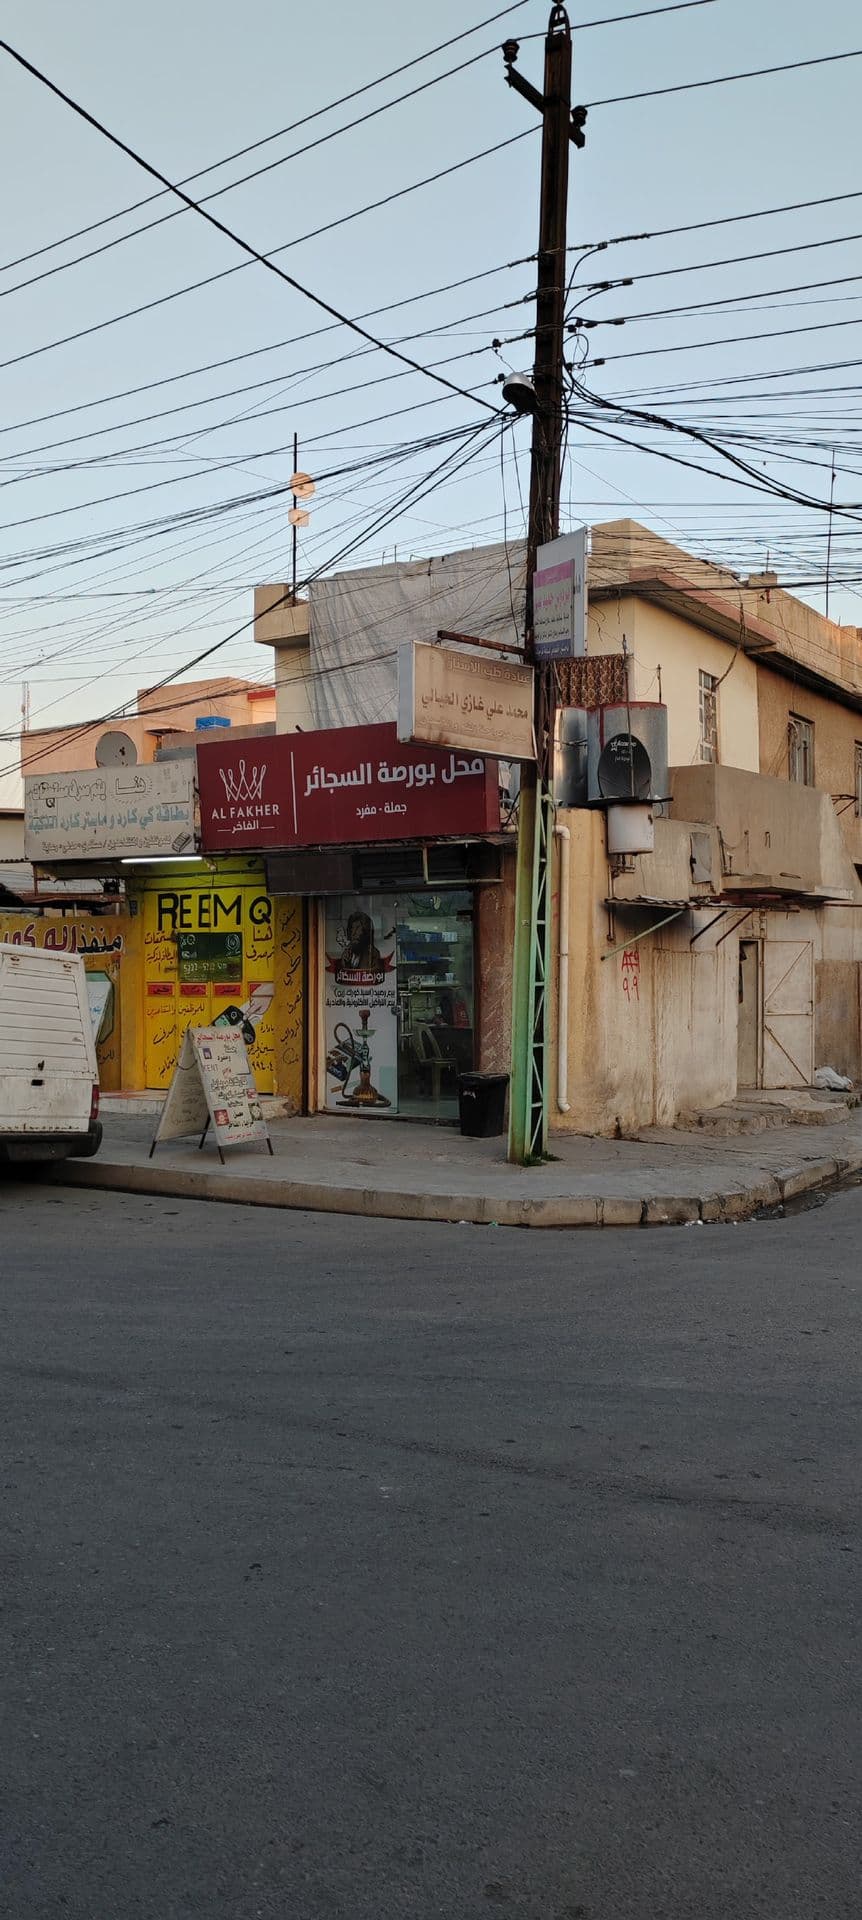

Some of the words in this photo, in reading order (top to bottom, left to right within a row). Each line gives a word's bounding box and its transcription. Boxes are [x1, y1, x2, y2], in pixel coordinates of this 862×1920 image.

[460, 694, 484, 715] غازي
[486, 701, 503, 721] علي
[377, 759, 436, 788] بورصة
[441, 755, 485, 783] محل
[304, 763, 372, 797] السجائر
[117, 808, 138, 829] كارد
[138, 807, 154, 829] كي
[157, 805, 190, 826] بطاقة
[211, 807, 227, 820] AL
[230, 803, 281, 819] FAKHER
[356, 804, 377, 819] مفرد
[384, 802, 408, 815] جملة
[231, 820, 260, 834] الفاخر
[157, 893, 242, 931] REEM
[249, 896, 272, 926] Q
[76, 924, 124, 954] منفذ
[361, 971, 384, 983] بورصة
